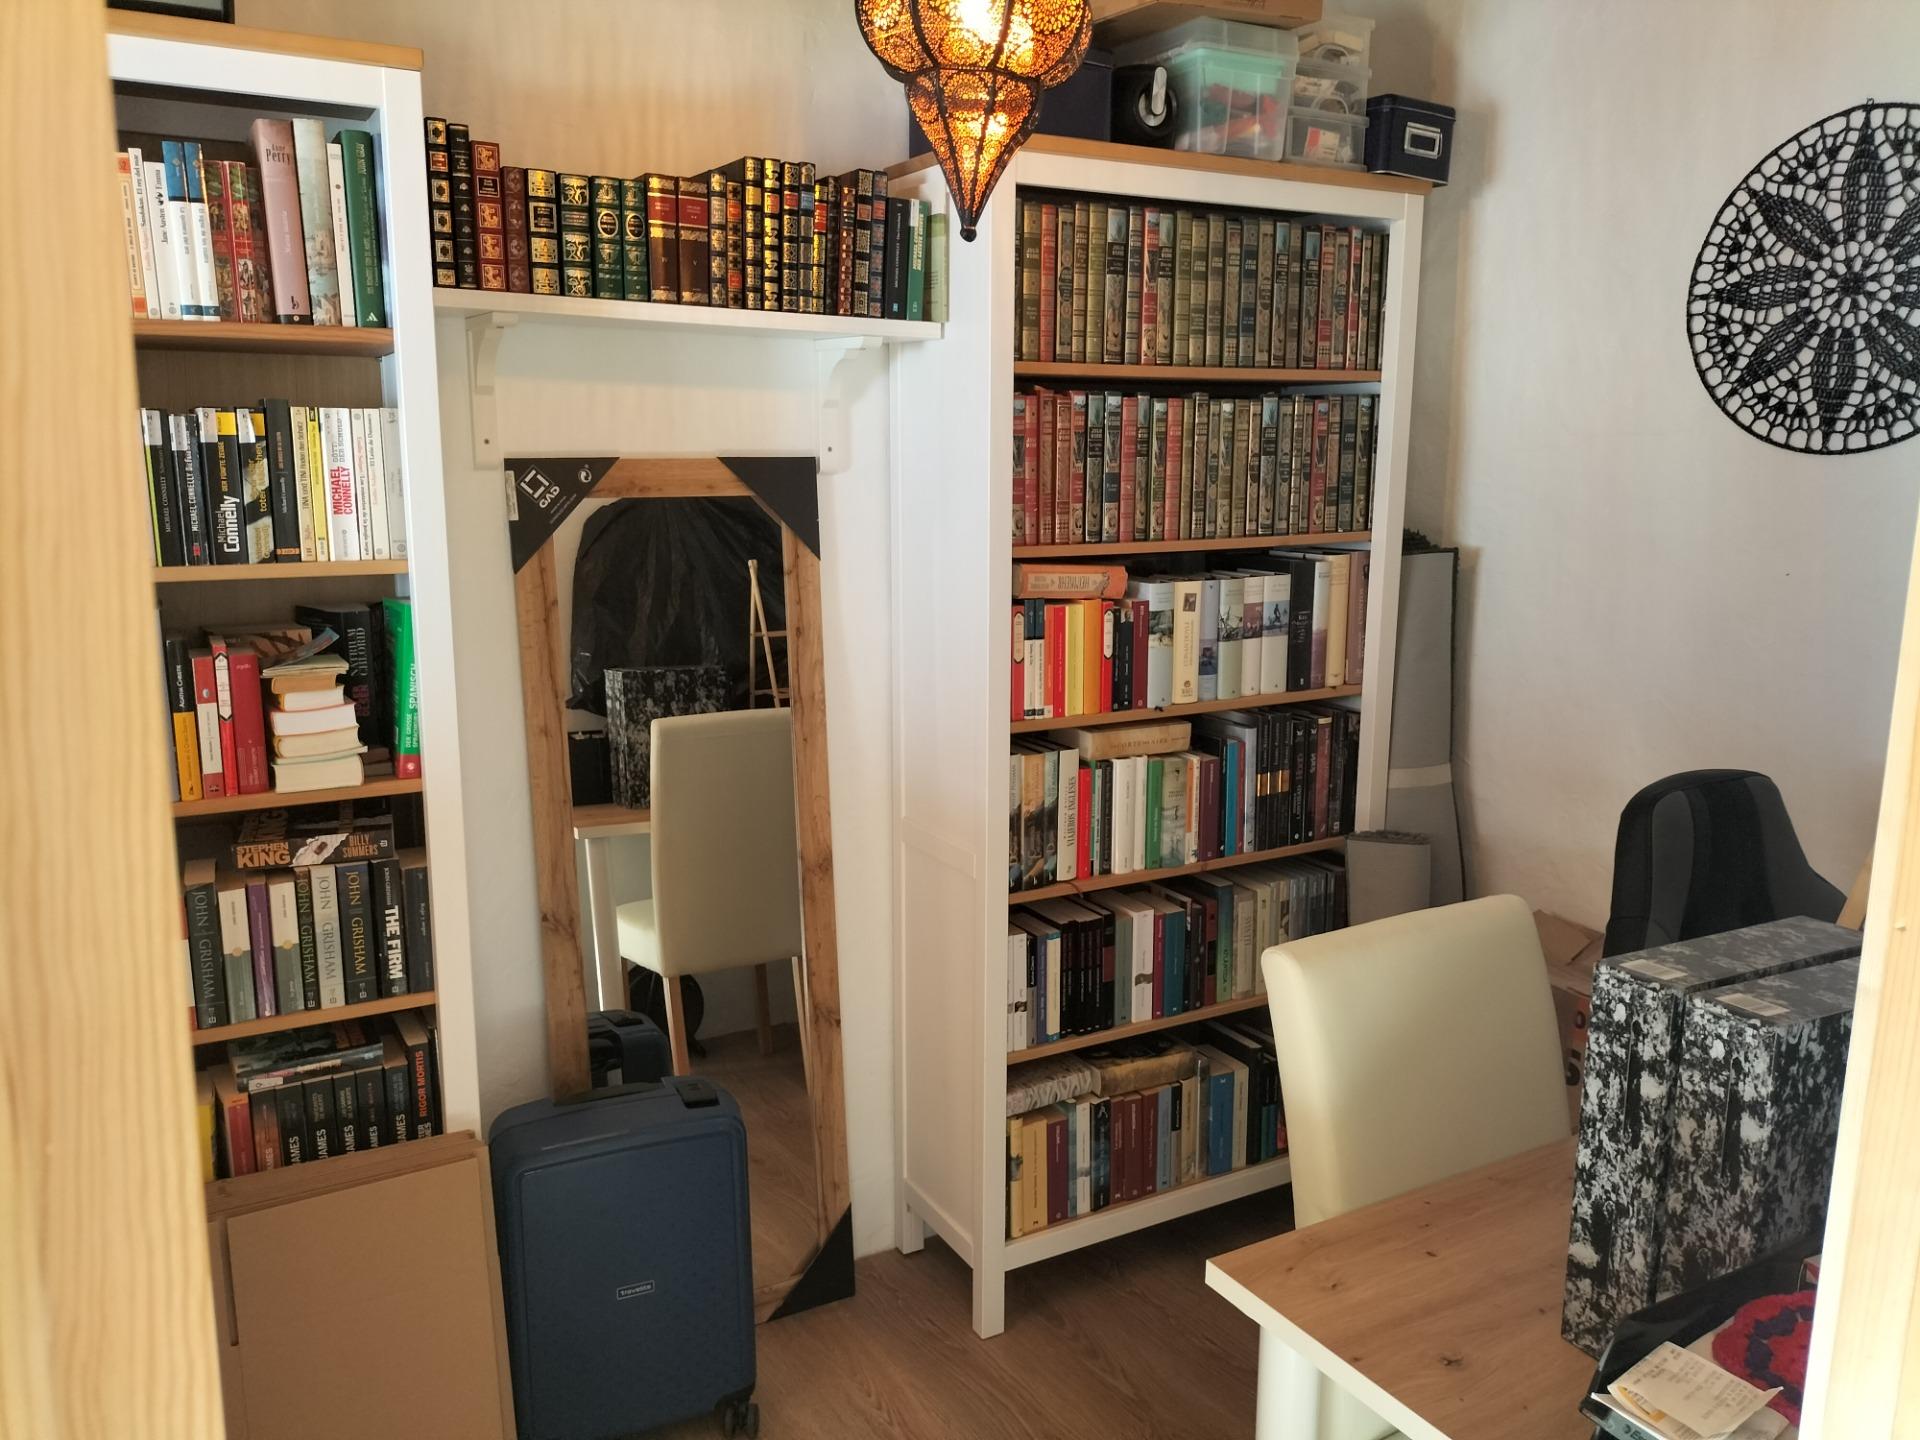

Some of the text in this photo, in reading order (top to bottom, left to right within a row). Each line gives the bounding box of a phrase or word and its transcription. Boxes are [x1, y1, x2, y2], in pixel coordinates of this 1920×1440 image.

[265, 147, 291, 164] Perry
[155, 169, 168, 244] Jane Austen Emma
[186, 473, 197, 503] CONNELLY
[257, 489, 268, 512] toten
[330, 466, 343, 515] MICHAEL
[340, 466, 353, 515] CONNELLY
[163, 507, 171, 532] MICHAEL
[190, 505, 199, 531] MICHAEL
[215, 510, 226, 542] Michael
[220, 495, 240, 552] Connelly
[347, 628, 359, 676] NATRIUM
[357, 627, 369, 676] CHLORID
[409, 663, 418, 709] SPANISCH
[236, 842, 289, 855] STEPHEN
[236, 851, 291, 868] KING
[342, 844, 378, 858] SUMMERS
[349, 833, 370, 844] BILLY
[192, 891, 215, 999] JOHN GRISHAM
[297, 879, 315, 983] JOHN GRISHAM
[317, 876, 336, 980] JOHN GRISHAM
[346, 871, 366, 975] JOHN GRISHAM
[385, 905, 403, 980] THE FIRM
[415, 1050, 428, 1117] RIGOR MORTIS
[369, 1126, 379, 1148] AMES
